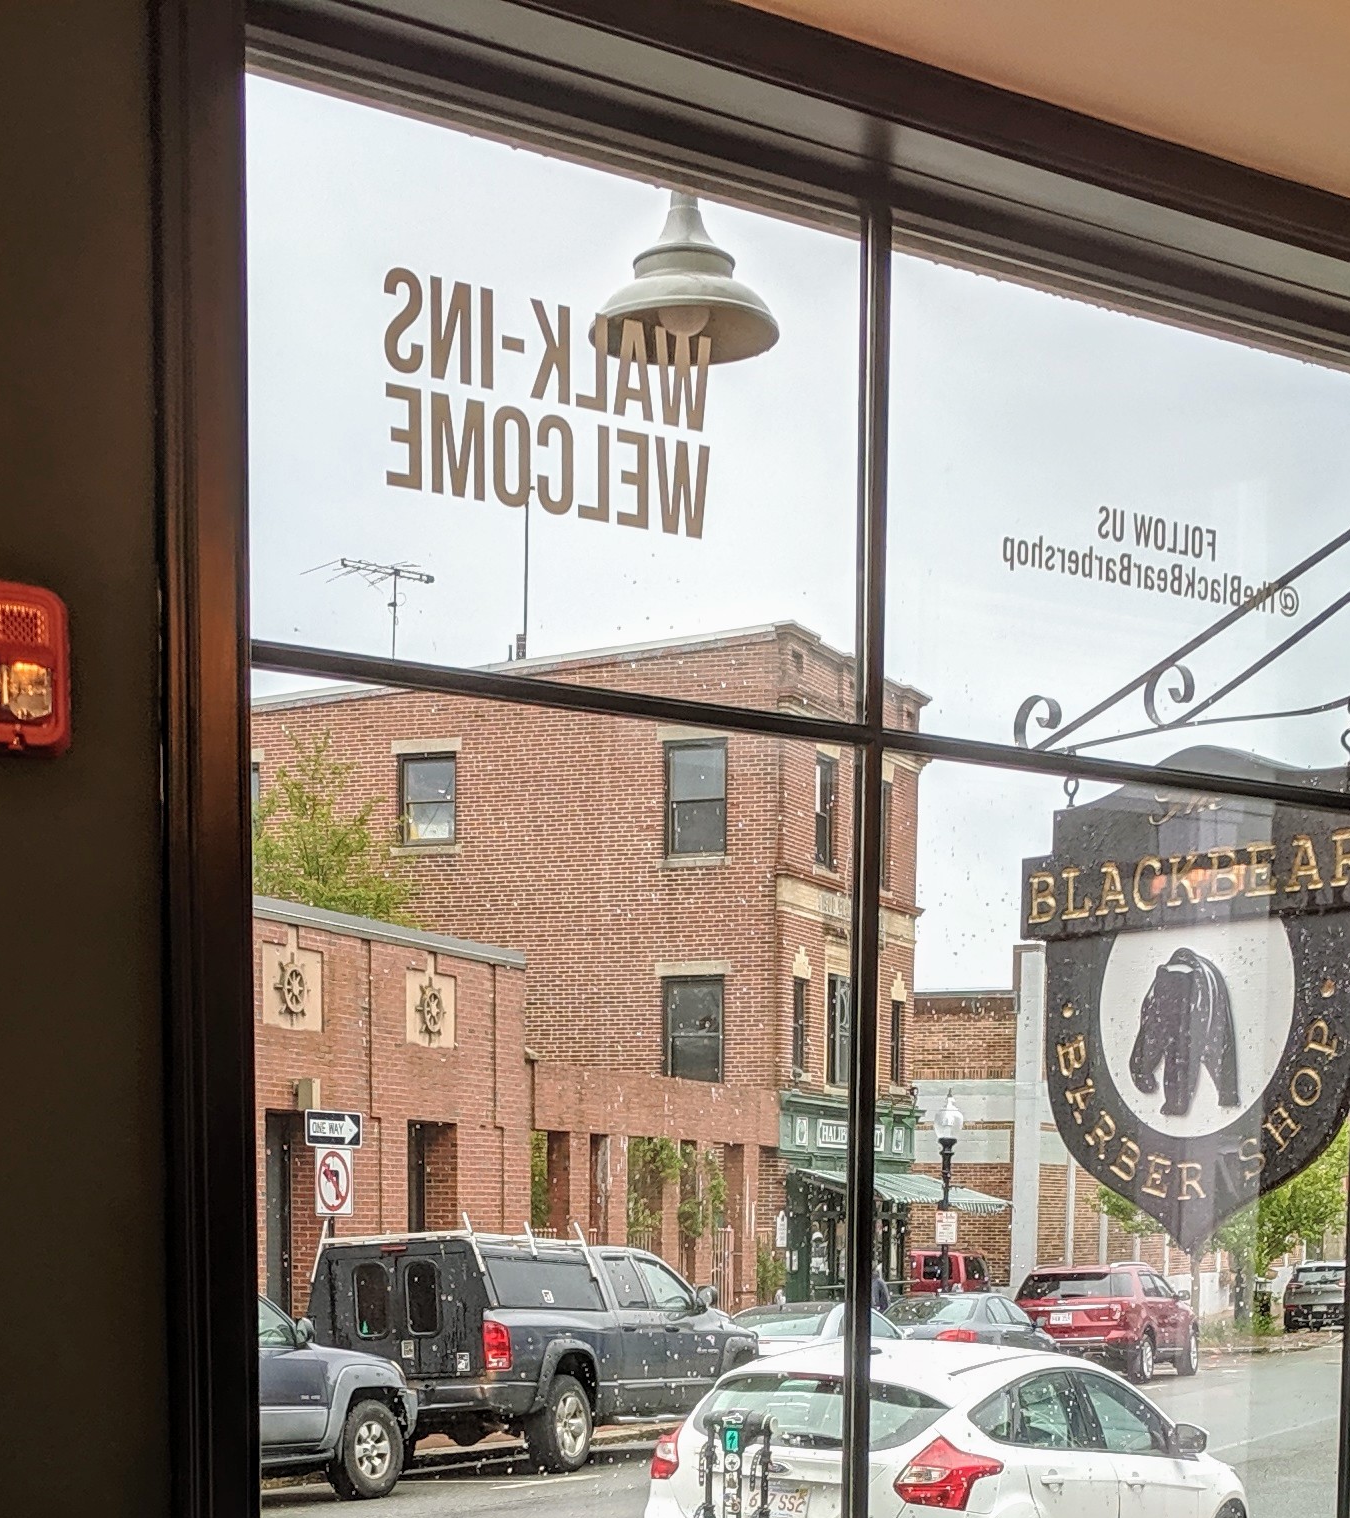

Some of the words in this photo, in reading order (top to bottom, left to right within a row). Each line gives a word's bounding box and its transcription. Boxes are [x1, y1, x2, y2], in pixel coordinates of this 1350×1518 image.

[1056, 1033, 1207, 1201] BARBER
[1238, 1019, 1339, 1181] SHOP
[312, 1121, 327, 1135] ONE
[328, 1122, 345, 1136] WAY
[822, 1124, 848, 1143] HALIB
